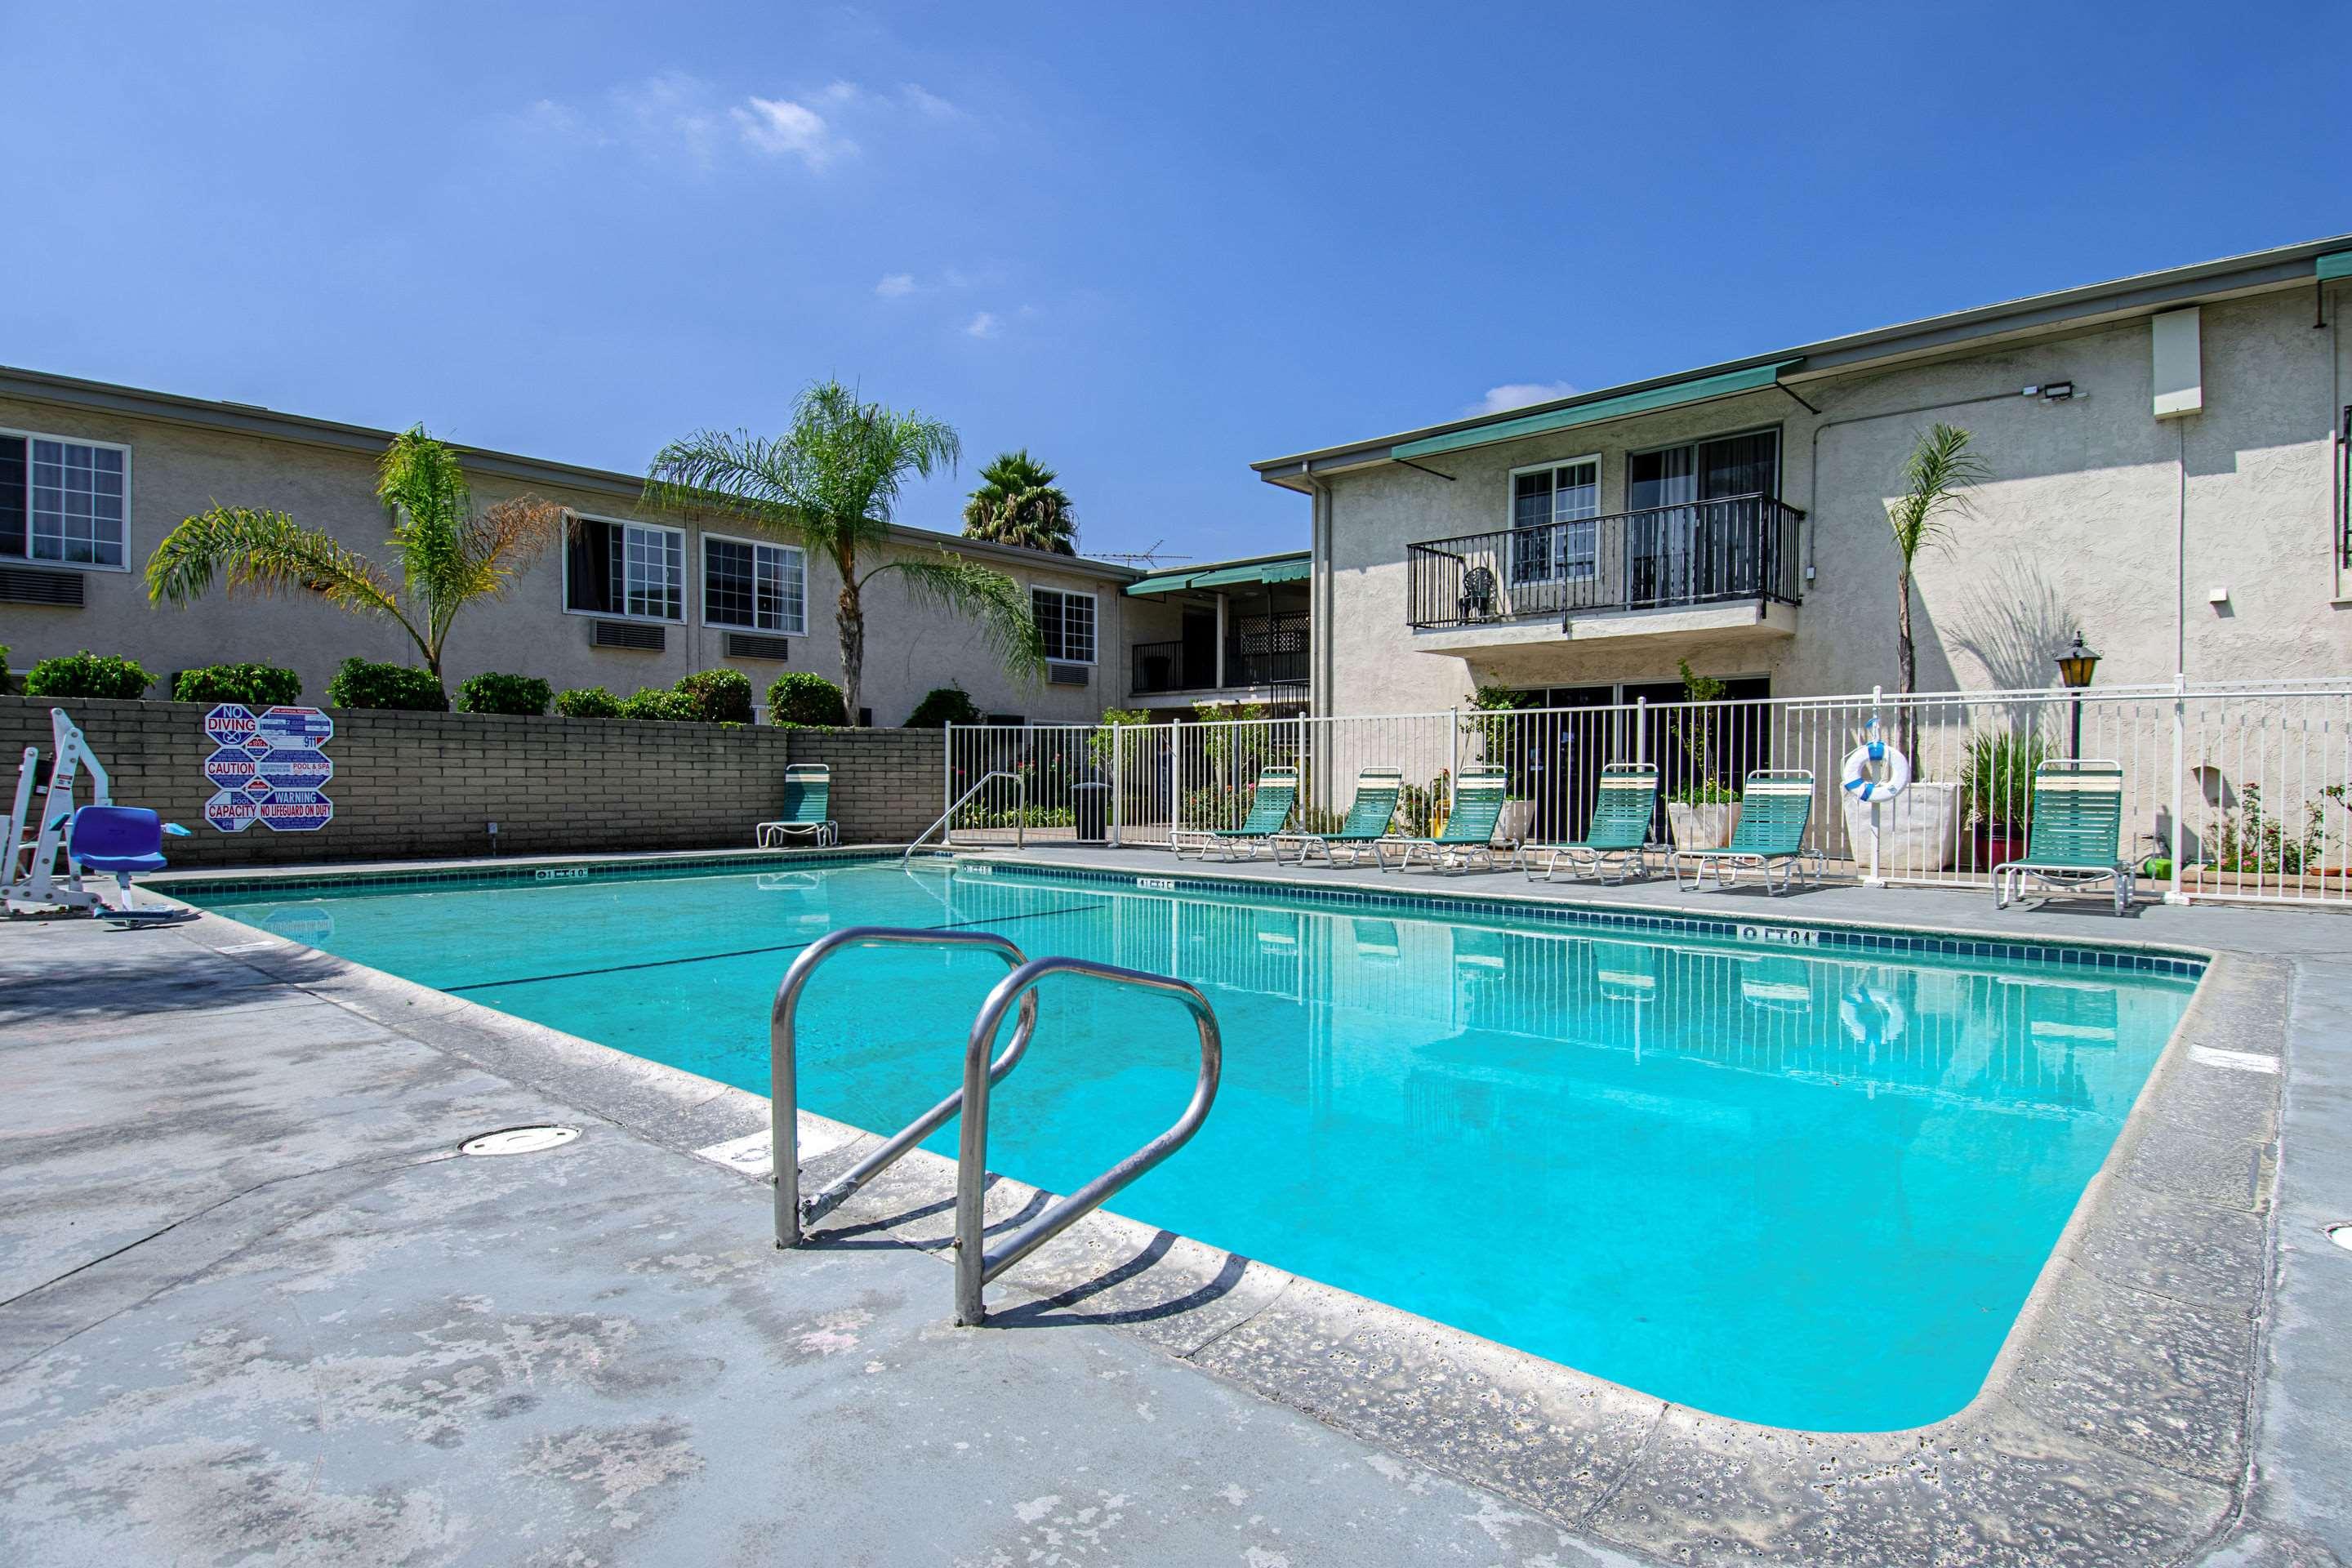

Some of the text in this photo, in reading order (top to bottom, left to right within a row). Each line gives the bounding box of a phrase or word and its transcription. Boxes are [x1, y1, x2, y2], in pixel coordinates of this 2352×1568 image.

[223, 706, 243, 719] NO
[208, 719, 256, 731] DIVING
[304, 736, 317, 747] 911
[208, 763, 256, 775] CAUTION
[274, 792, 317, 804] WARNING
[208, 805, 256, 817] CAPACITY
[261, 804, 331, 817] NO LIFEGUARD ON DUTY
